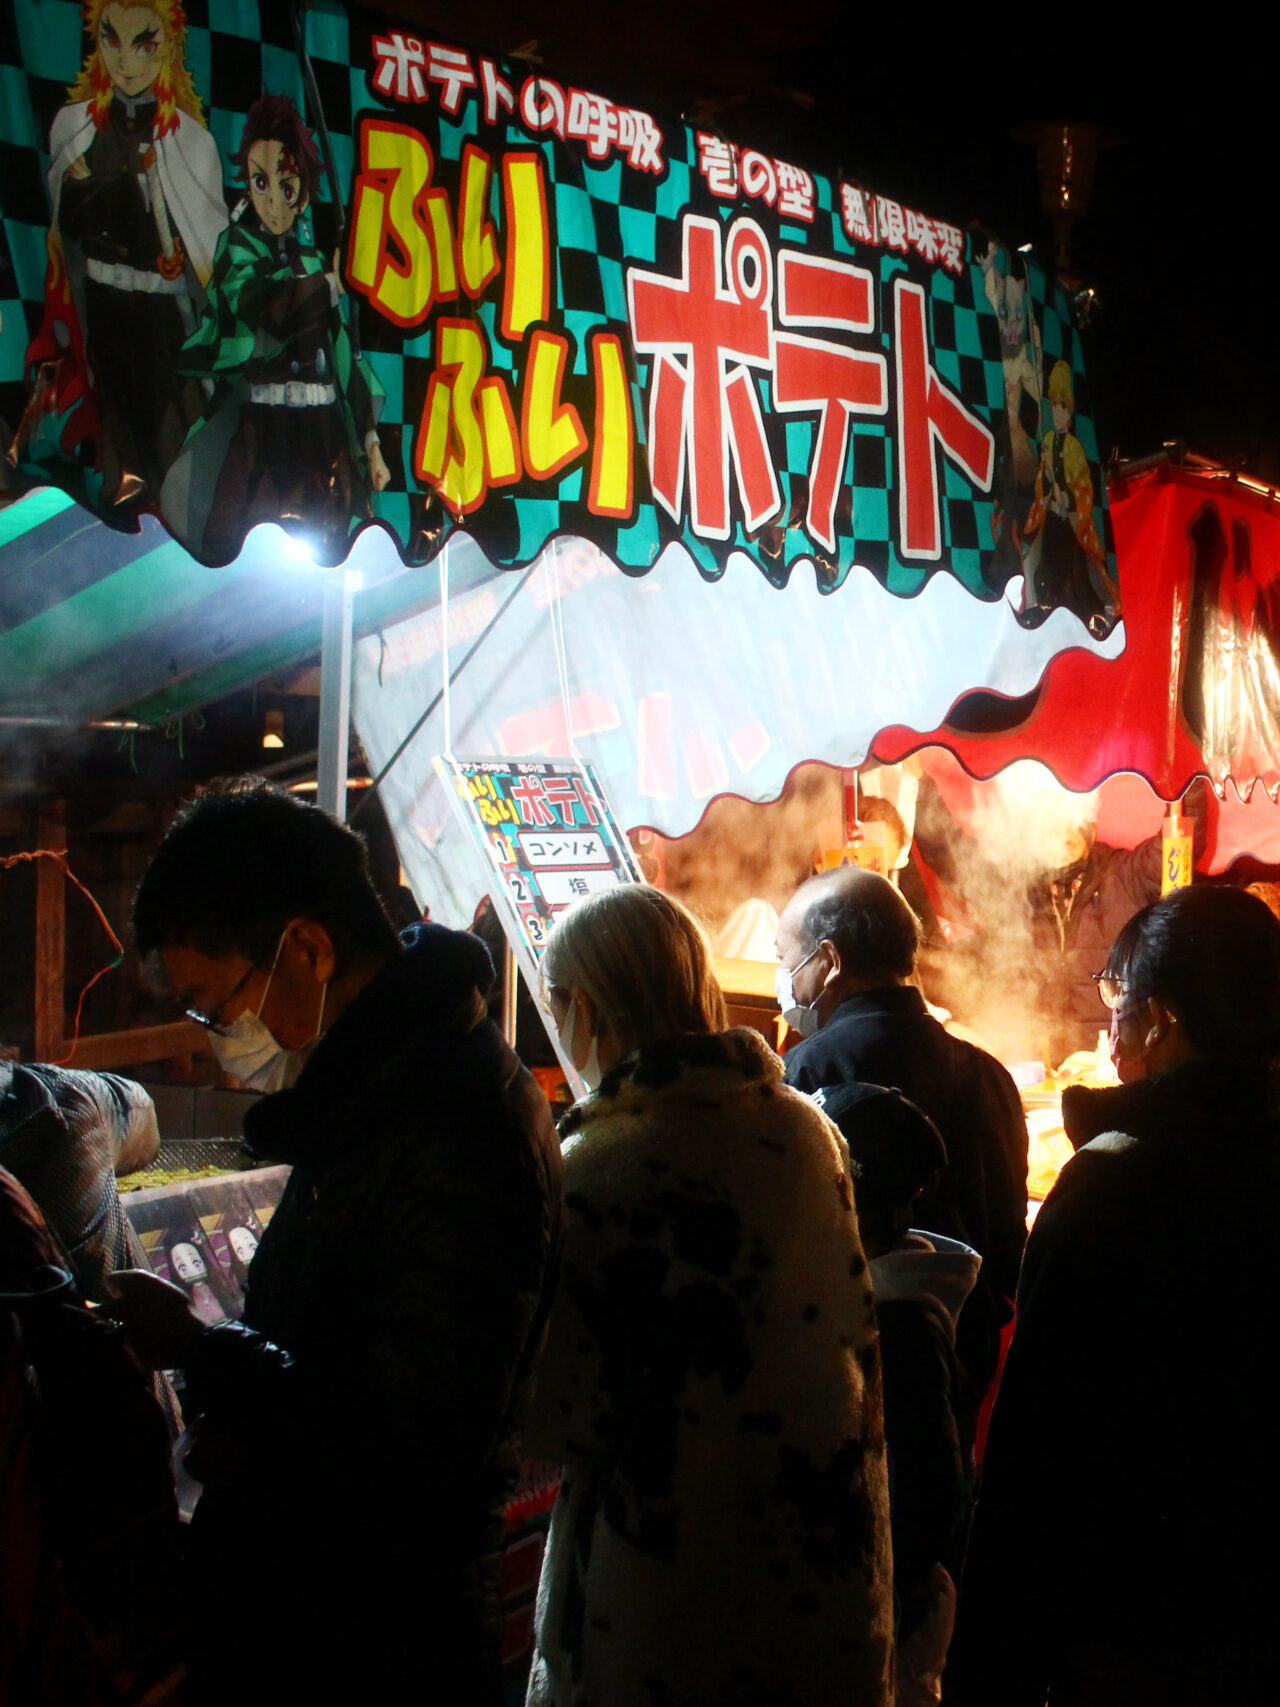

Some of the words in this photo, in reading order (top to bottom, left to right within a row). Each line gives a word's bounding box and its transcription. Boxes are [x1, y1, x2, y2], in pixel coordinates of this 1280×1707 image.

[371, 31, 664, 174] ポテトの呼吸
[626, 213, 996, 561] ポテト
[510, 774, 608, 827] ポテト
[528, 841, 598, 857] コンソメ
[510, 880, 527, 901] 2
[528, 919, 544, 941] 3
